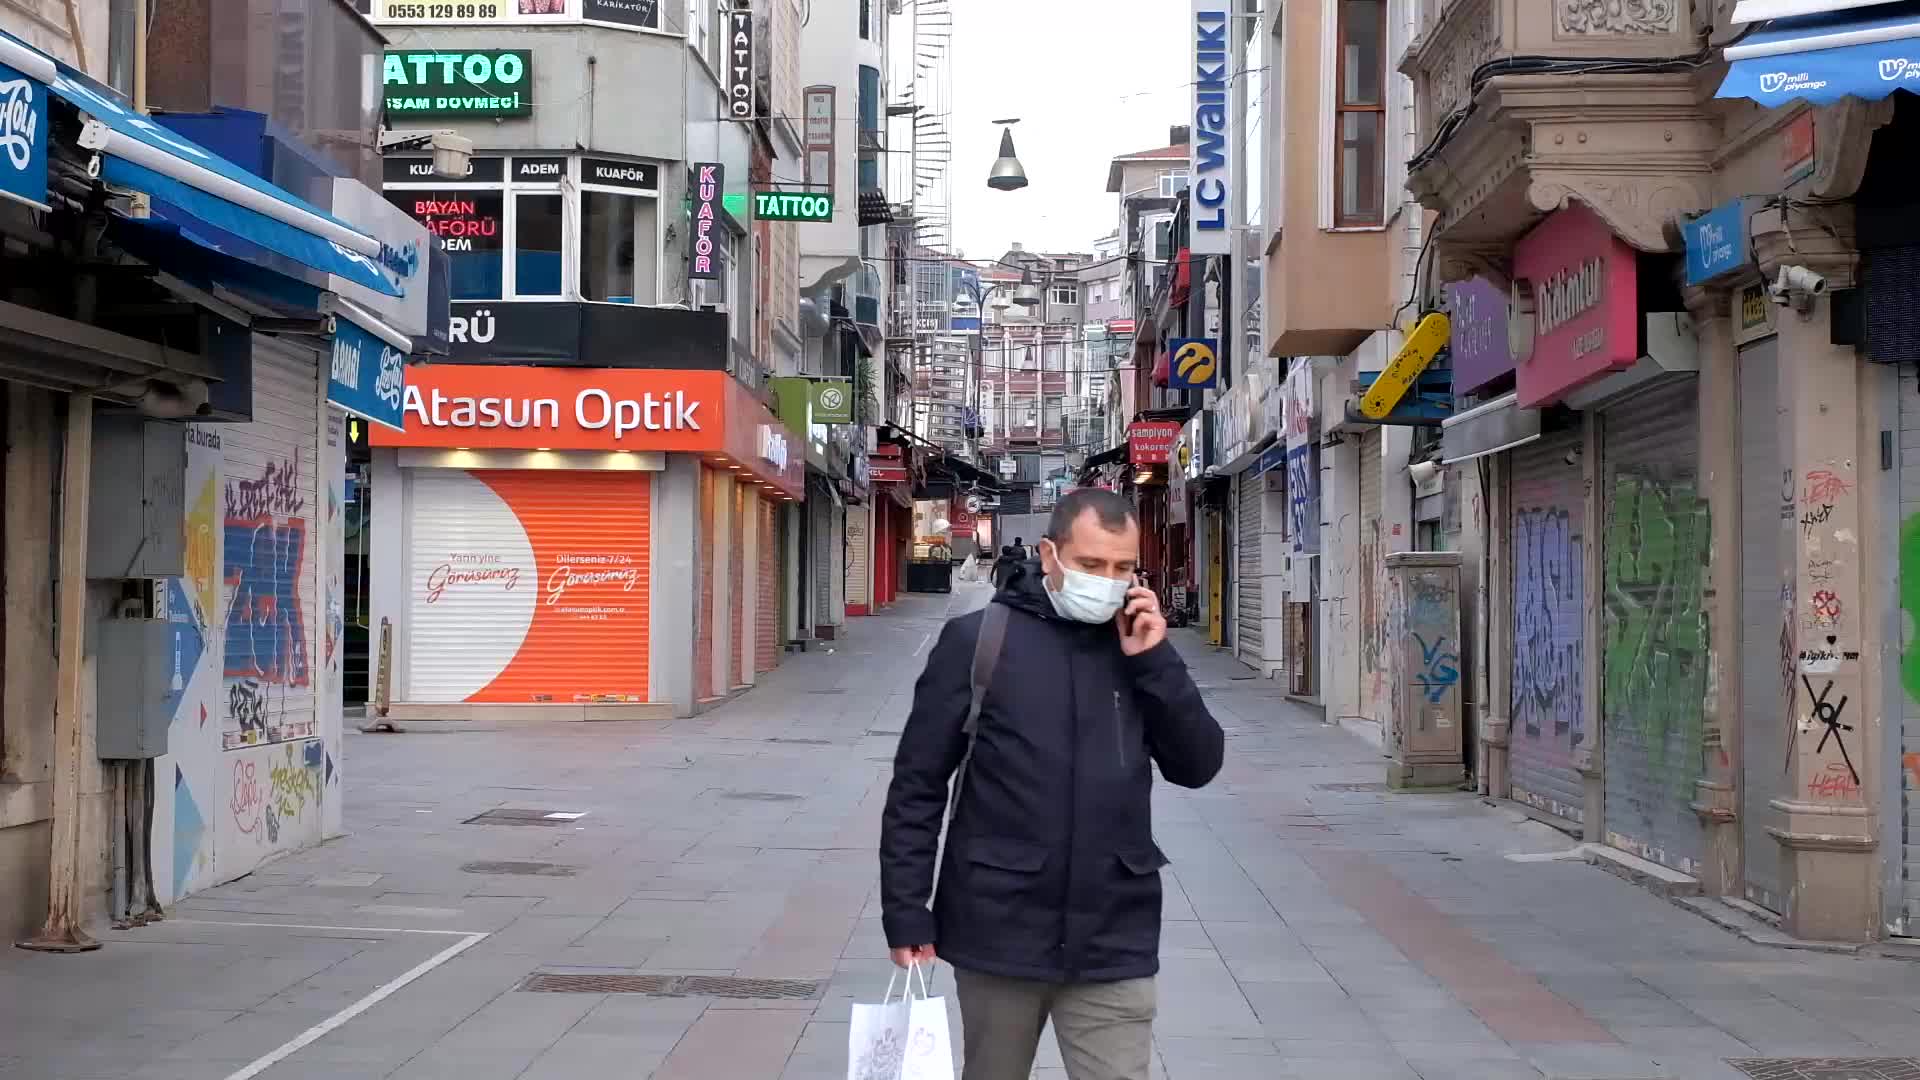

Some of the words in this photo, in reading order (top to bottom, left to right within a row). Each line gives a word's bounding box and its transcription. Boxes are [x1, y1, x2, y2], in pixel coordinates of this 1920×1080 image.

[388, 4, 427, 19] 0553
[429, 4, 453, 19] 129
[456, 4, 475, 18] 89
[478, 4, 497, 18] 89
[383, 53, 523, 85] ATTOO
[732, 14, 749, 115] TATTOO
[1784, 80, 1827, 92] piyango
[1787, 72, 1809, 83] milli
[409, 163, 473, 175] KUAÜ
[520, 163, 559, 175] ADEM
[595, 165, 644, 181] KUAFÖR
[415, 201, 474, 215] BAYAN
[756, 194, 829, 217] TATTOO
[427, 216, 496, 236] AFÖRÜ
[695, 166, 716, 273] KUAFÖR
[449, 309, 495, 343] RÜ
[403, 384, 559, 428] Atasun
[574, 387, 701, 440] Optik
